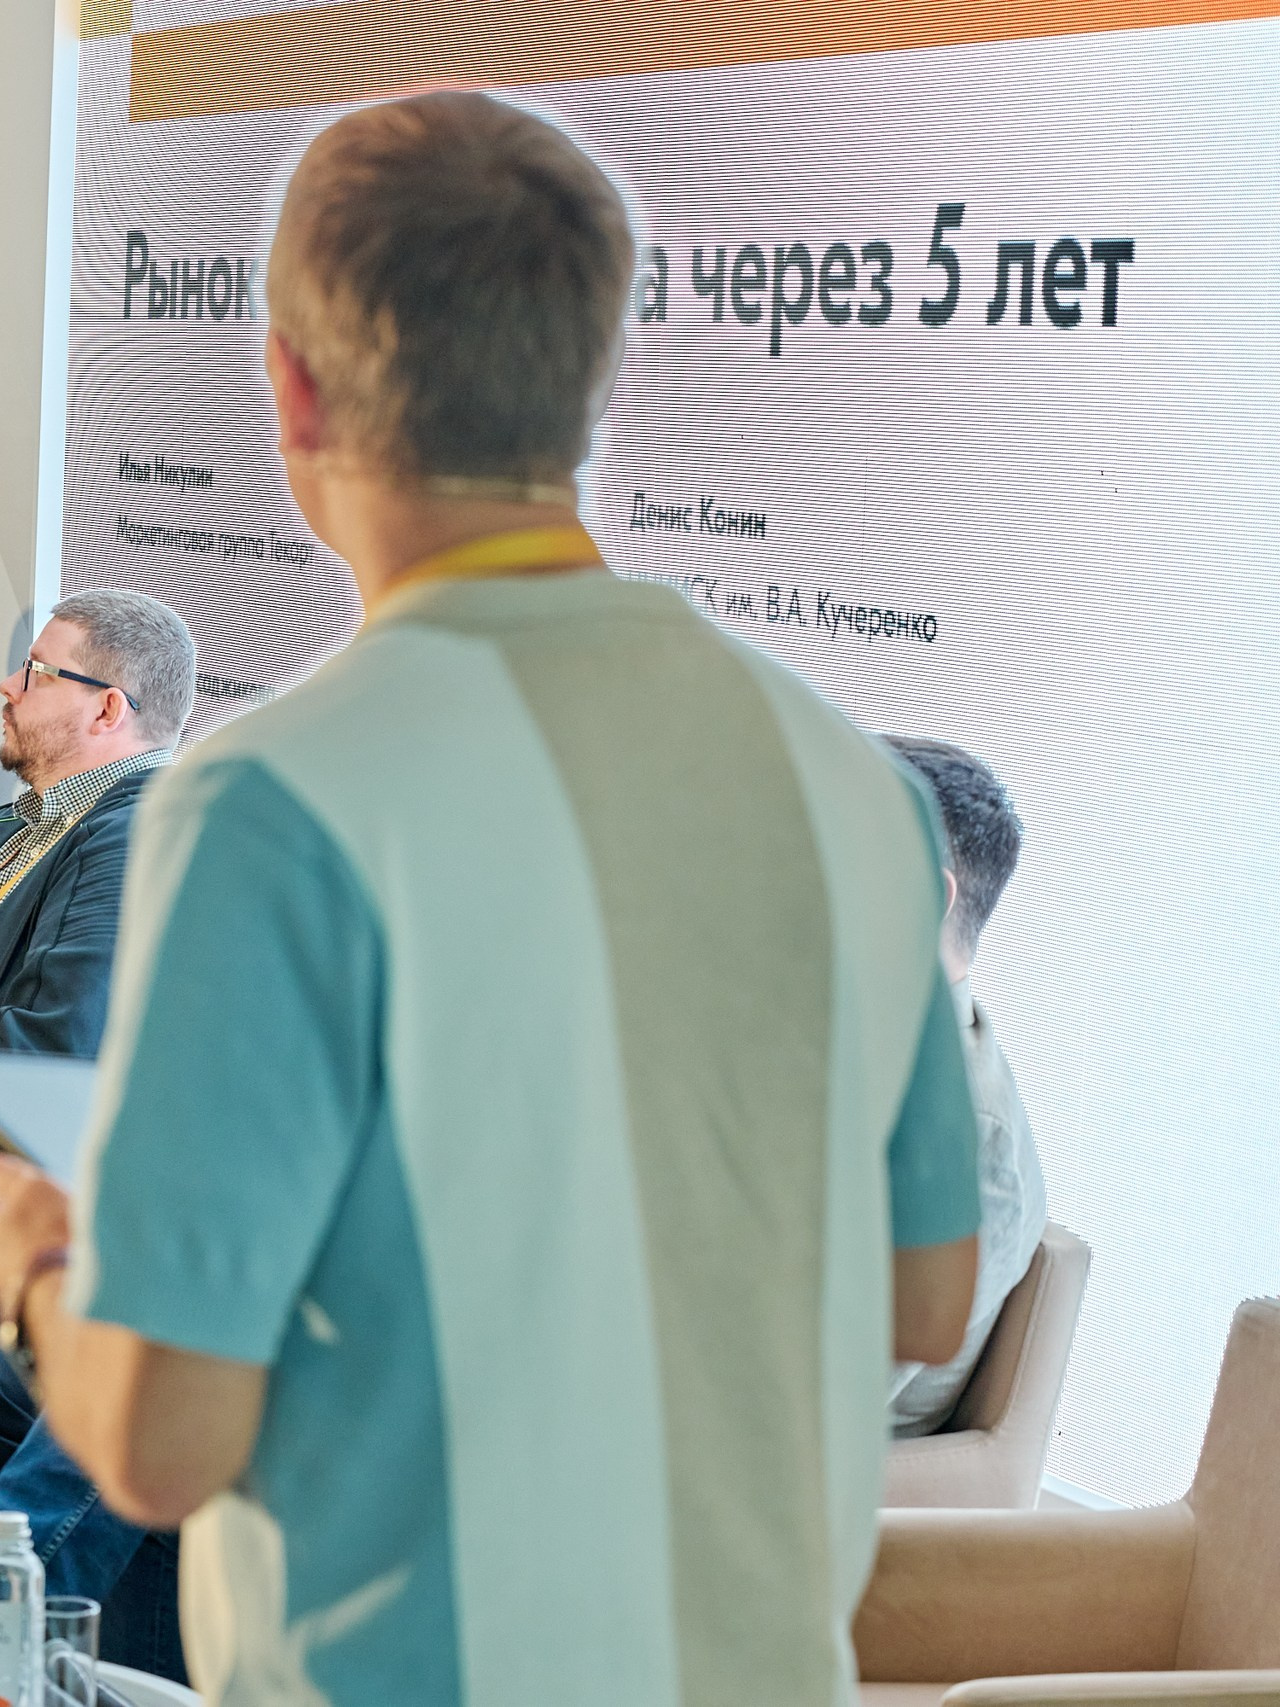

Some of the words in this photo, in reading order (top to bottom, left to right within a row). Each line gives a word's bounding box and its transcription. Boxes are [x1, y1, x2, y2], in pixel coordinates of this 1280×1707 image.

[691, 238, 893, 358] через
[919, 203, 965, 327] 5
[987, 236, 1135, 329] лет
[119, 450, 151, 483] Илья
[154, 453, 213, 493] Никулин
[116, 514, 214, 554] Маркетинговая
[219, 532, 265, 564] группа
[630, 490, 692, 533] Денис
[699, 494, 766, 539] Конин
[725, 590, 757, 621] им.
[766, 585, 806, 626] В.А.
[817, 591, 937, 643] Кучеренко
